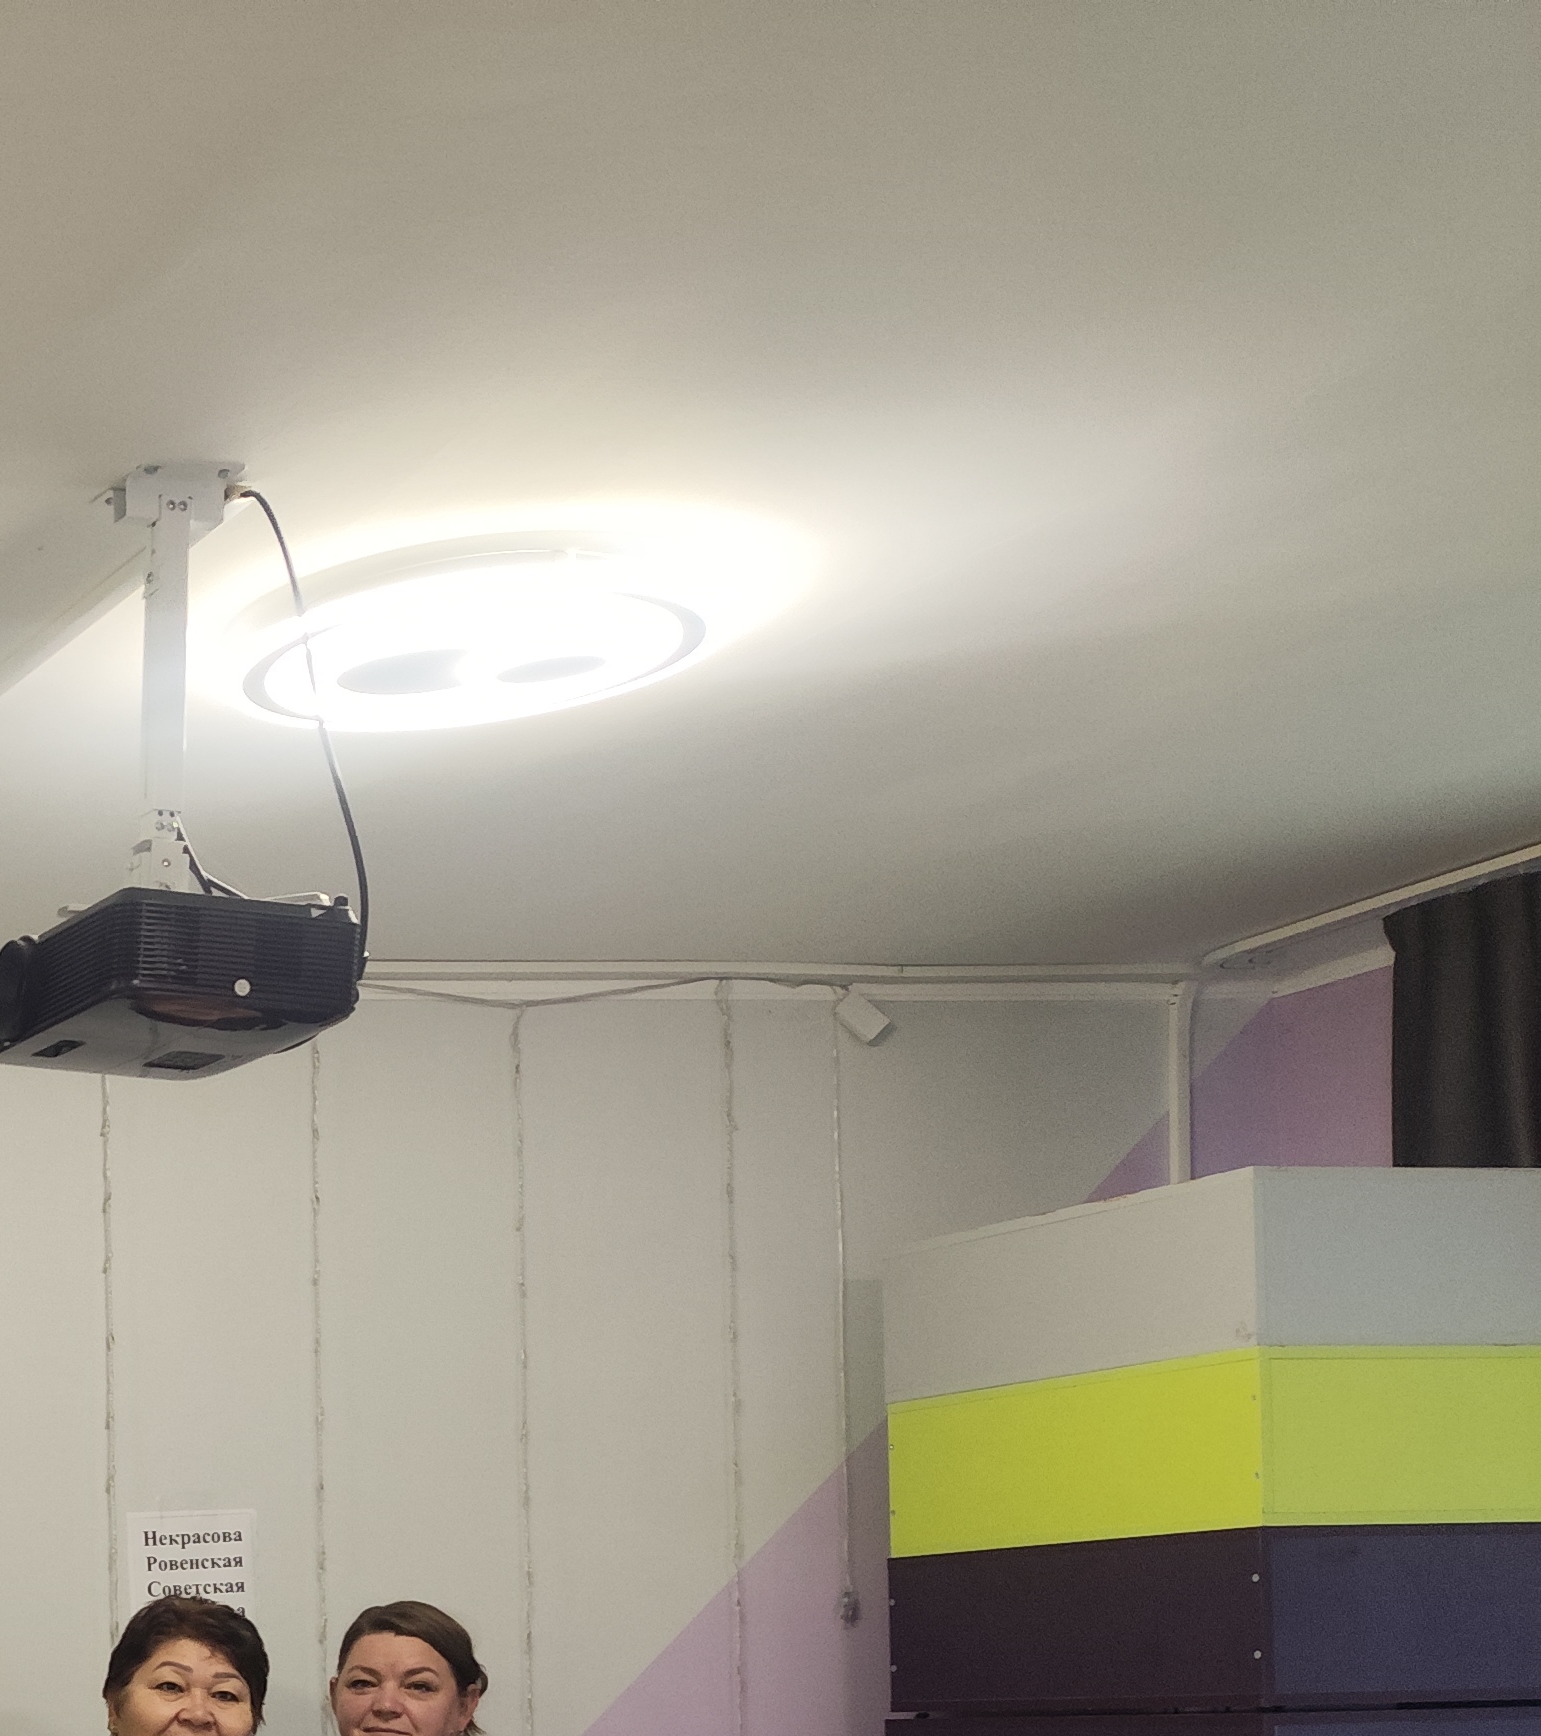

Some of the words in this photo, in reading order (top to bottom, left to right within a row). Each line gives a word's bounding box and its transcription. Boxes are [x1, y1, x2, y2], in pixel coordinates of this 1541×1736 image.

[143, 1530, 243, 1549] Некрасова
[146, 1556, 244, 1572] Ровенская
[147, 1580, 245, 1597] Советская
